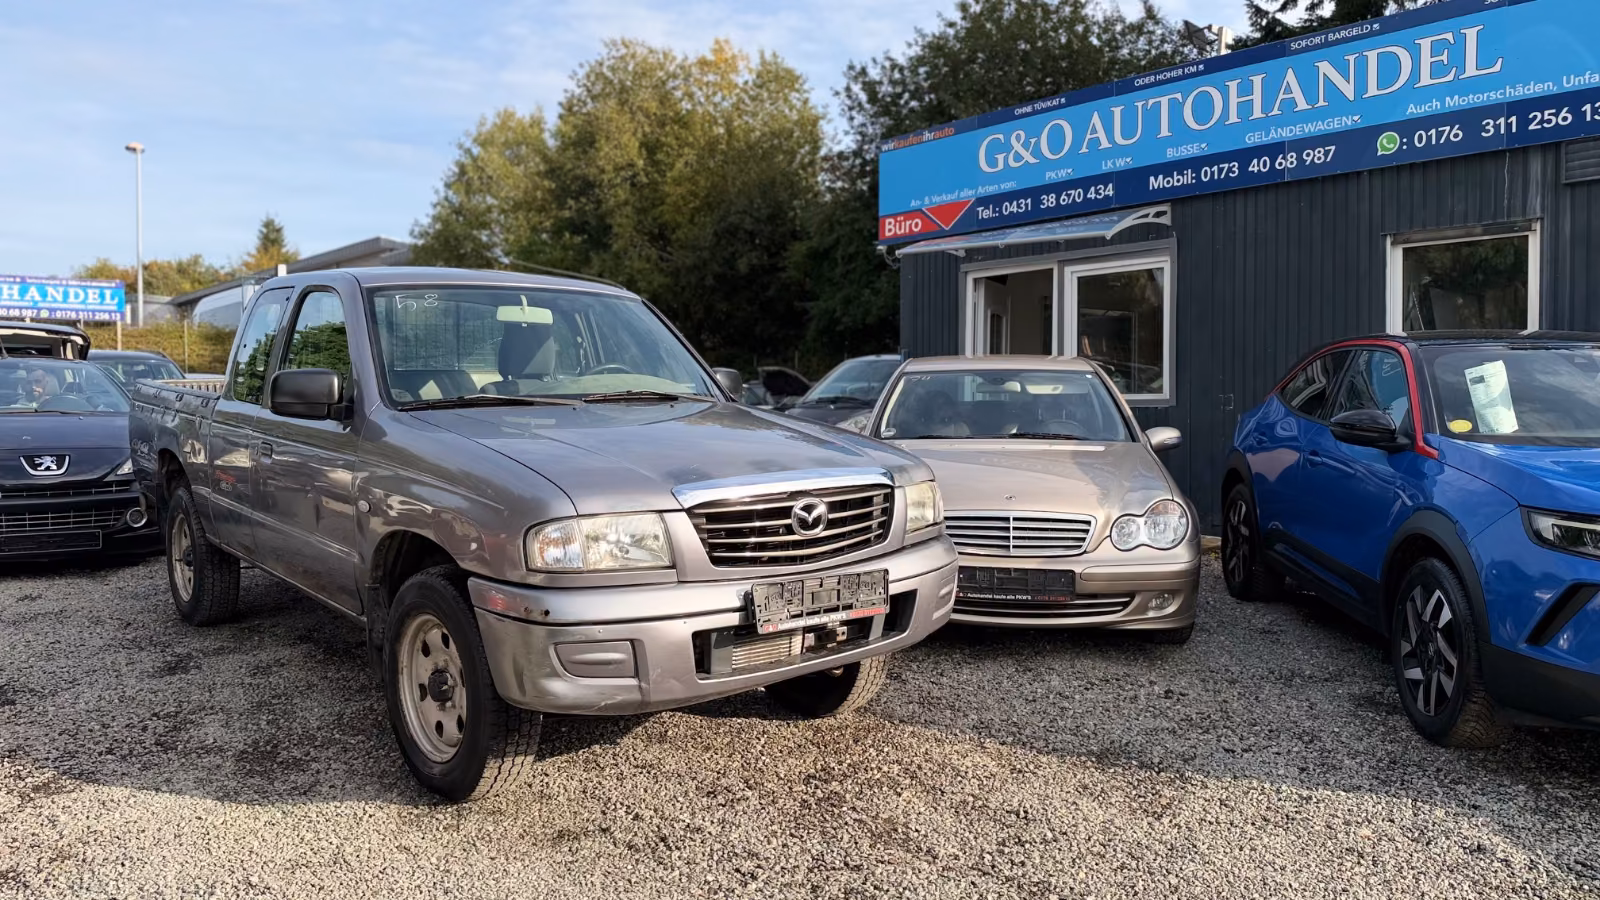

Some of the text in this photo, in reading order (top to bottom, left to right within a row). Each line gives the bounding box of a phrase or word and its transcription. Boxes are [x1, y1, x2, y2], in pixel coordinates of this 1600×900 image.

[1290, 24, 1371, 50] SOFORT BARGELD
[1134, 65, 1197, 87] ODER HOHER KM
[978, 24, 1503, 173] G&O AUTOHANDEL
[1406, 71, 1600, 116] Auch Motorschäden, Unfa
[1014, 106, 1033, 116] OHNE
[881, 126, 955, 152] wirkaufenihrauto
[1413, 124, 1463, 148] 0176
[1480, 115, 1517, 137] 311
[1528, 107, 1573, 130] 256
[1045, 169, 1067, 181] PKW
[1166, 143, 1200, 158] BUSSE
[1245, 115, 1351, 145] GELÄNDEWAGEN
[1149, 145, 1336, 191] Mobil: 0173 40 68 987
[932, 190, 959, 203] Verkauf
[960, 189, 976, 198] aller
[977, 183, 998, 195] Arten
[1000, 180, 1017, 190] von:
[977, 183, 1114, 220] Tel.: 0431 38 670 434
[884, 215, 922, 237] Büro
